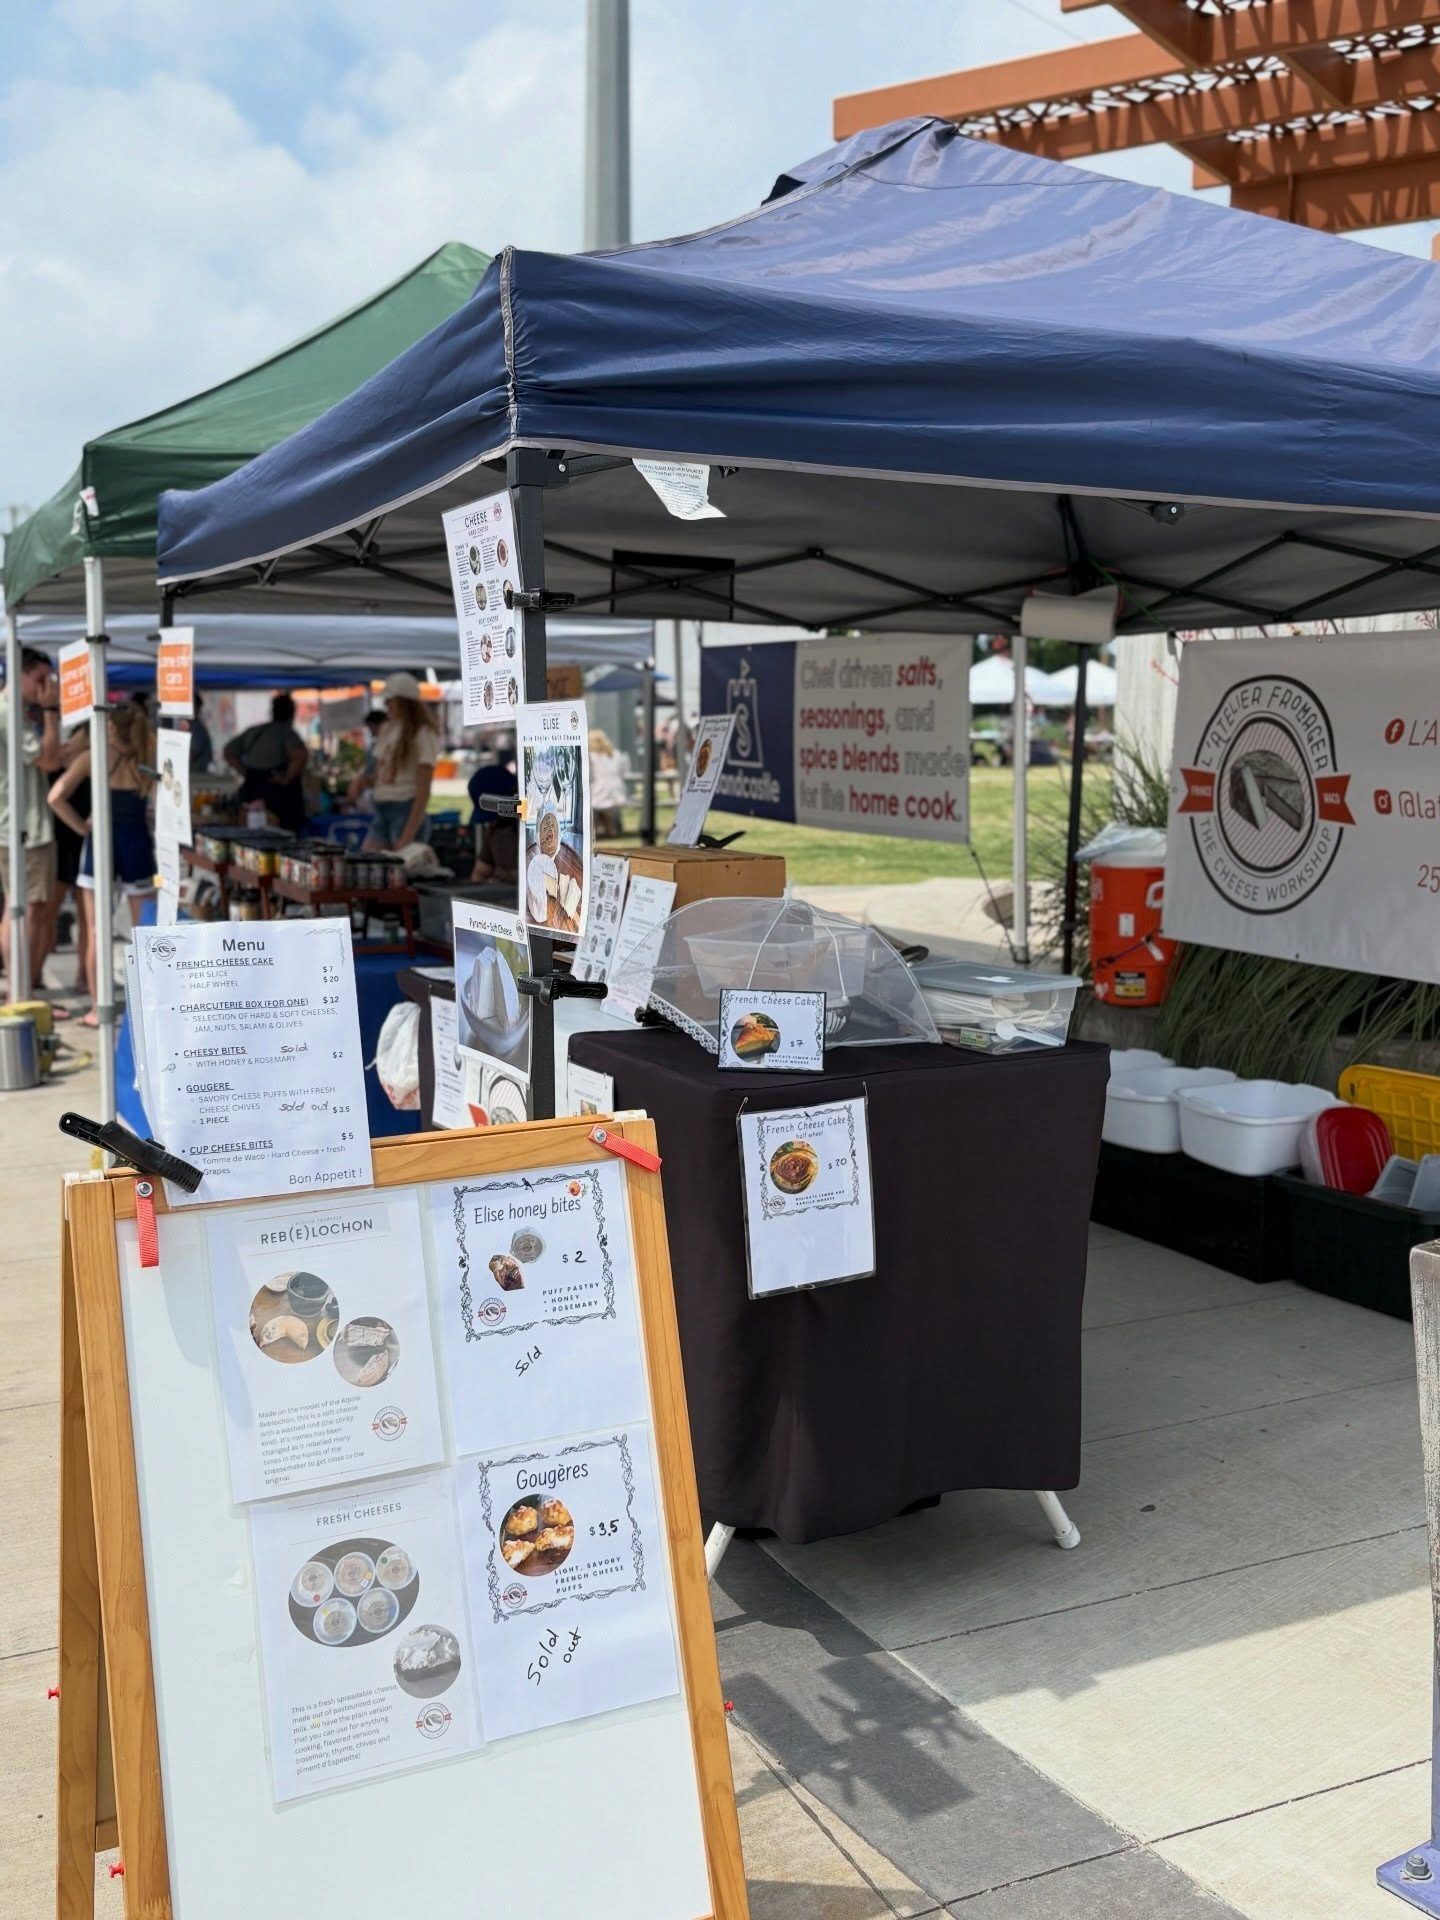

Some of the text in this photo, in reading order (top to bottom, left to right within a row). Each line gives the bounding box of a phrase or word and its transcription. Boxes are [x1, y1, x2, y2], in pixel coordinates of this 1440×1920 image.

[464, 511, 487, 528] CHEESE
[896, 656, 943, 690] salts,
[543, 717, 560, 730] ELISE
[800, 701, 935, 737] seasonings, and
[1202, 685, 1329, 772] L'ATELIER FROMAGER
[800, 742, 967, 777] spice blends made
[714, 769, 781, 803] andcastle
[849, 784, 899, 817] home
[904, 790, 962, 822] cook.
[1200, 819, 1333, 902] THE CHEESE WORKSHOP
[222, 938, 265, 951] Menu
[176, 957, 274, 969] FRENCH CHEESE CAKE
[189, 970, 228, 979] PER SLICE
[189, 980, 239, 989] HALF WHEEL
[180, 1001, 243, 1012] CHARCUTERIE
[245, 1000, 263, 1009] BOX
[287, 998, 309, 1007] ONE)
[730, 994, 816, 1006] French Cheese Cake
[192, 1008, 338, 1022] SELECTION OF HARD & SOFT CHEESES,
[194, 1025, 213, 1033] JAM,
[214, 1023, 237, 1032] NUTS,
[239, 1022, 267, 1031] SALAMI
[275, 1020, 303, 1029] OLIVES
[183, 1046, 247, 1057] CHEESY BITES
[196, 1056, 296, 1068] WITH HONEY & ROSEMARY
[186, 1082, 231, 1092] GOUGERE
[198, 1086, 336, 1103] SAVORY CHEESE PUFFS WITH FRESH
[199, 1103, 261, 1114] CHEESE CHIVES
[206, 1116, 230, 1124] PIECE
[766, 1116, 846, 1134] French Cheese Cake
[189, 1140, 274, 1155] CUP CHEESE BITES
[202, 1145, 346, 1165] Tomme de Waco Hard Cheese fresh
[203, 1168, 231, 1178] Grapes
[289, 1174, 311, 1185] Bon
[314, 1167, 356, 1184] Appetit
[474, 1196, 581, 1224] Elise honey bites
[260, 1218, 373, 1245] REB(E)LOCHON
[542, 1282, 600, 1296] PUFF PASTRY
[551, 1294, 579, 1304] HONEY
[552, 1300, 598, 1312] ROSEMARY
[258, 1410, 277, 1418] Made
[287, 1406, 299, 1414] the
[299, 1402, 320, 1411] model
[516, 1463, 589, 1490] Gougères
[316, 1512, 350, 1527] FRESH
[354, 1502, 402, 1519] CHEESES
[554, 1556, 621, 1576] LIGHT, SAVORY
[555, 1565, 624, 1584] FRENCH CHEESE
[556, 1583, 583, 1594] PUFFS
[291, 1706, 305, 1714] This
[318, 1698, 336, 1707] fresh
[336, 1690, 373, 1703] spreadable
[292, 1714, 310, 1724] made
[312, 1711, 323, 1720] out
[372, 1697, 386, 1705] cow
